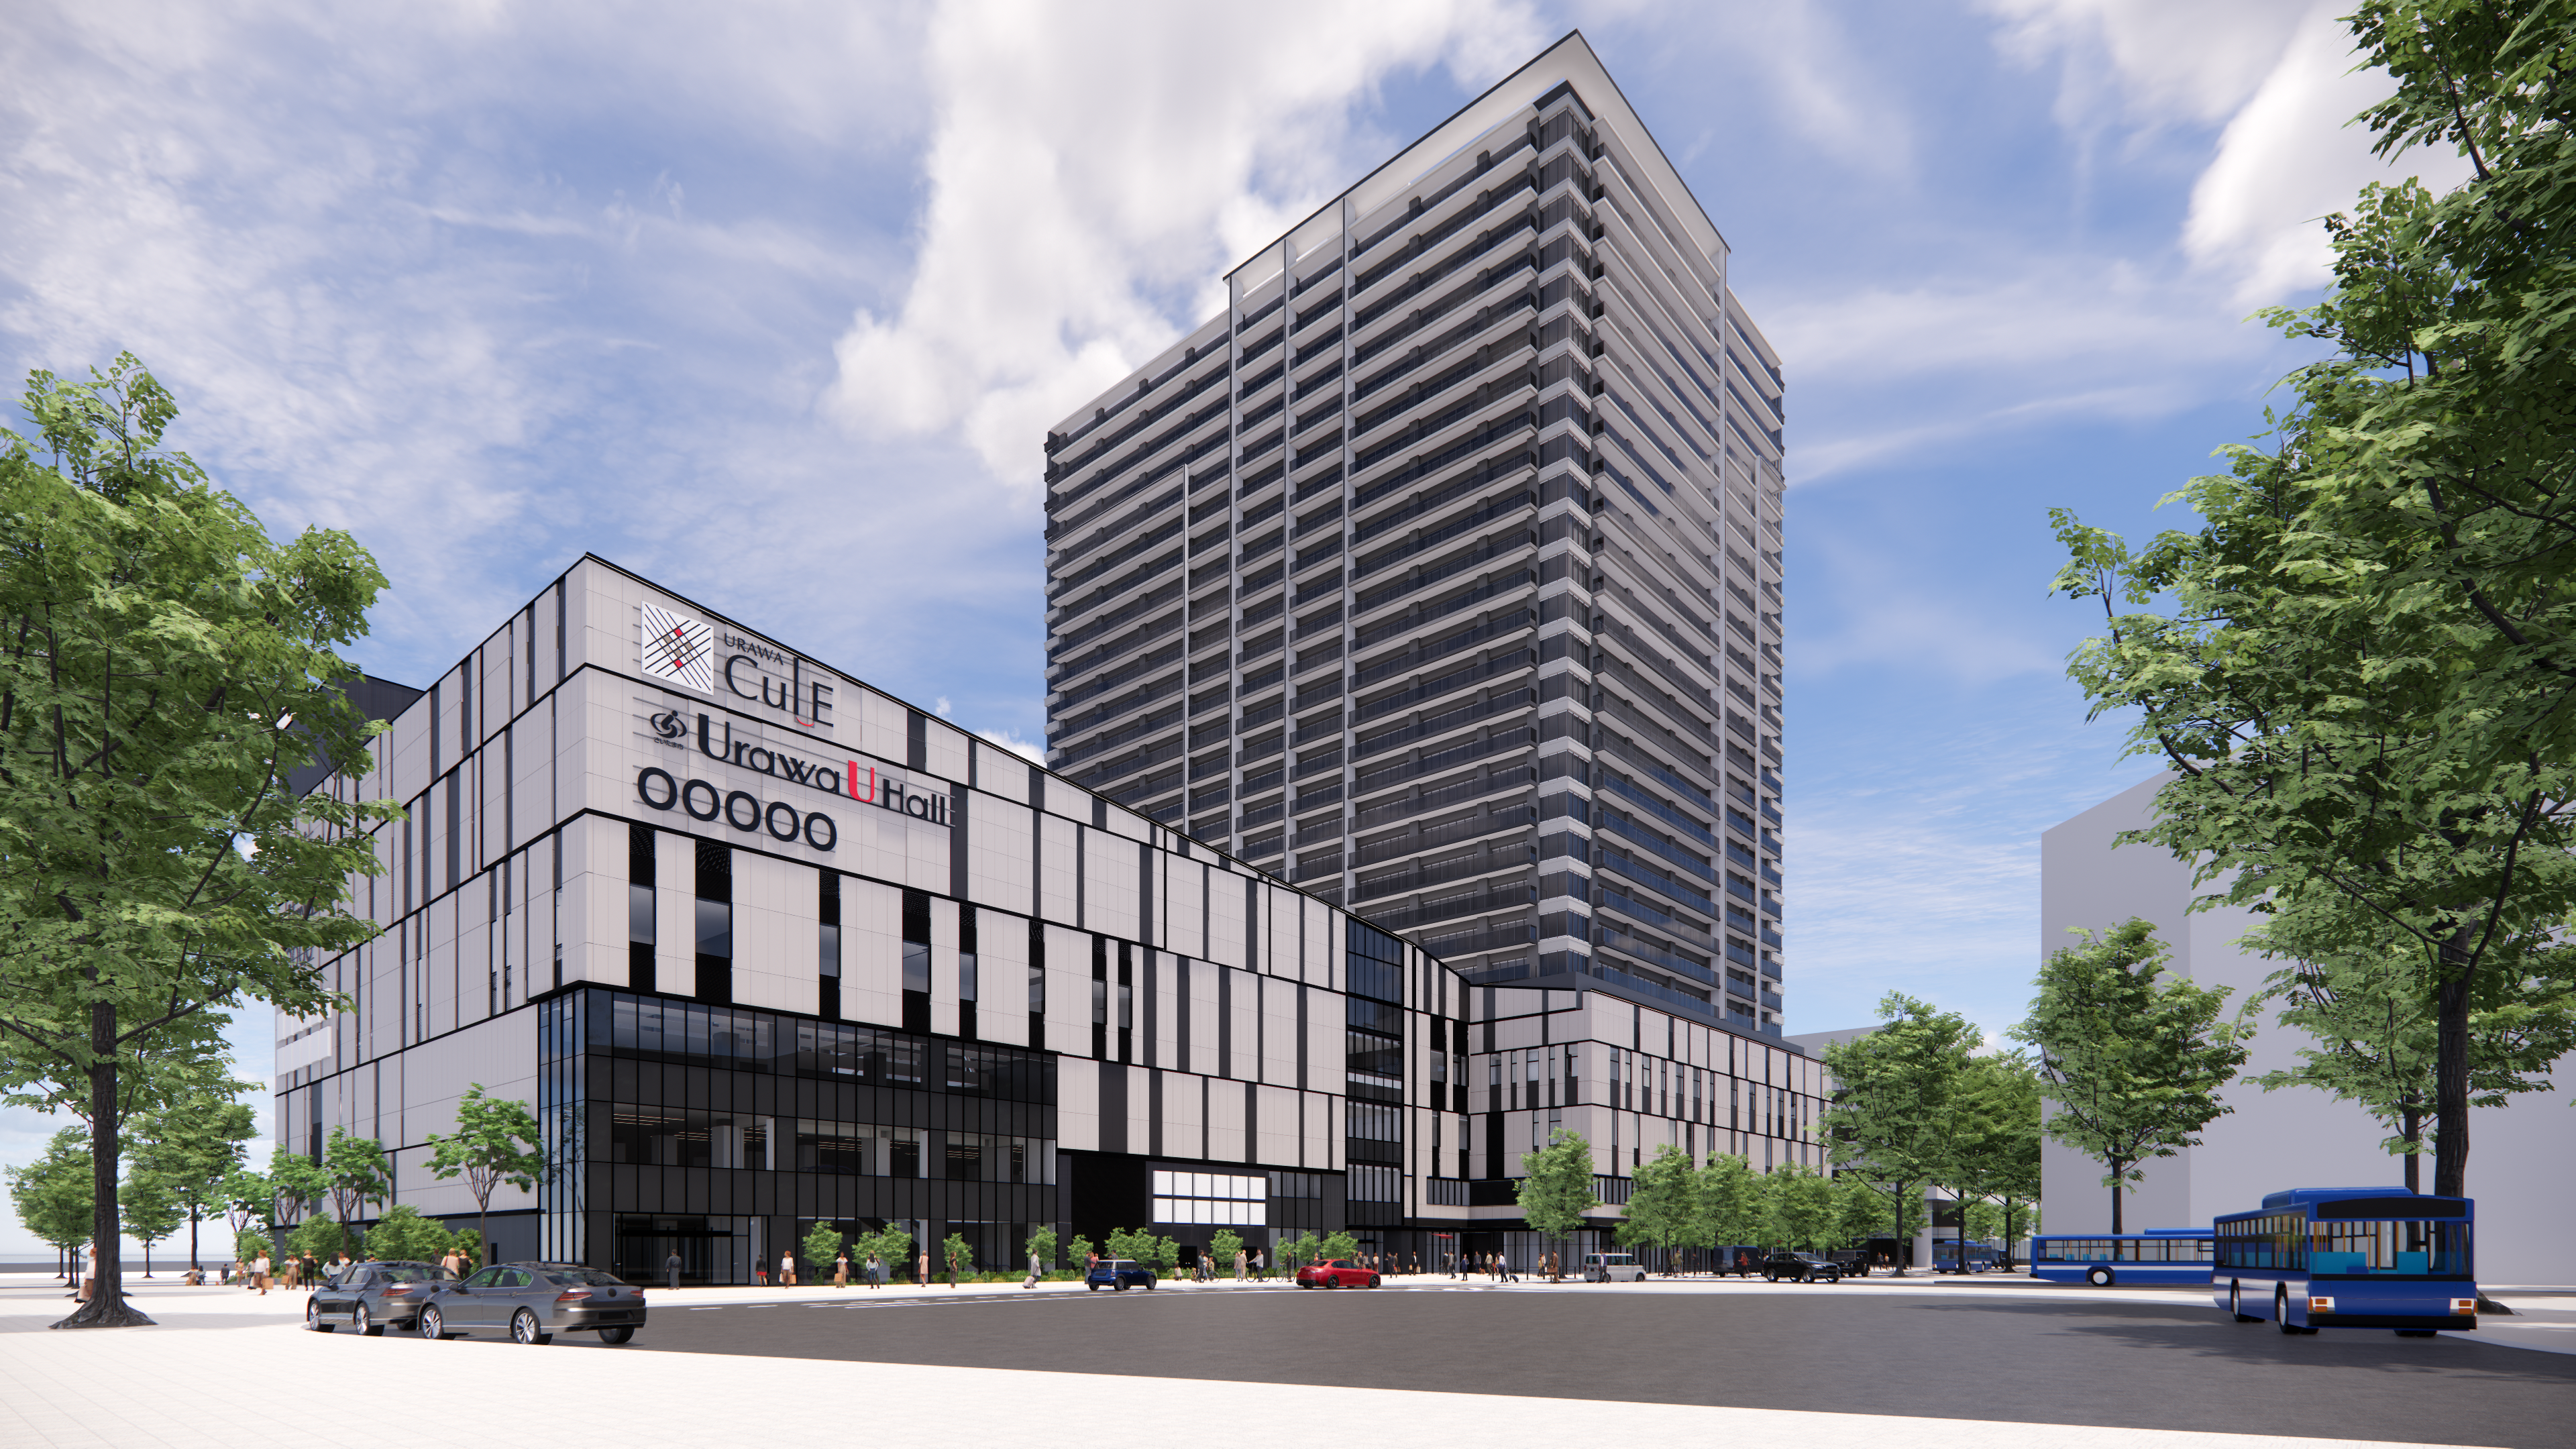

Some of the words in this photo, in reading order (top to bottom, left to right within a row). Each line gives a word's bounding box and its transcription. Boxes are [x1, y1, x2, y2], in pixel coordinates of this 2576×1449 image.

[724, 633, 784, 665] URAWA
[653, 737, 684, 750] さいたま市
